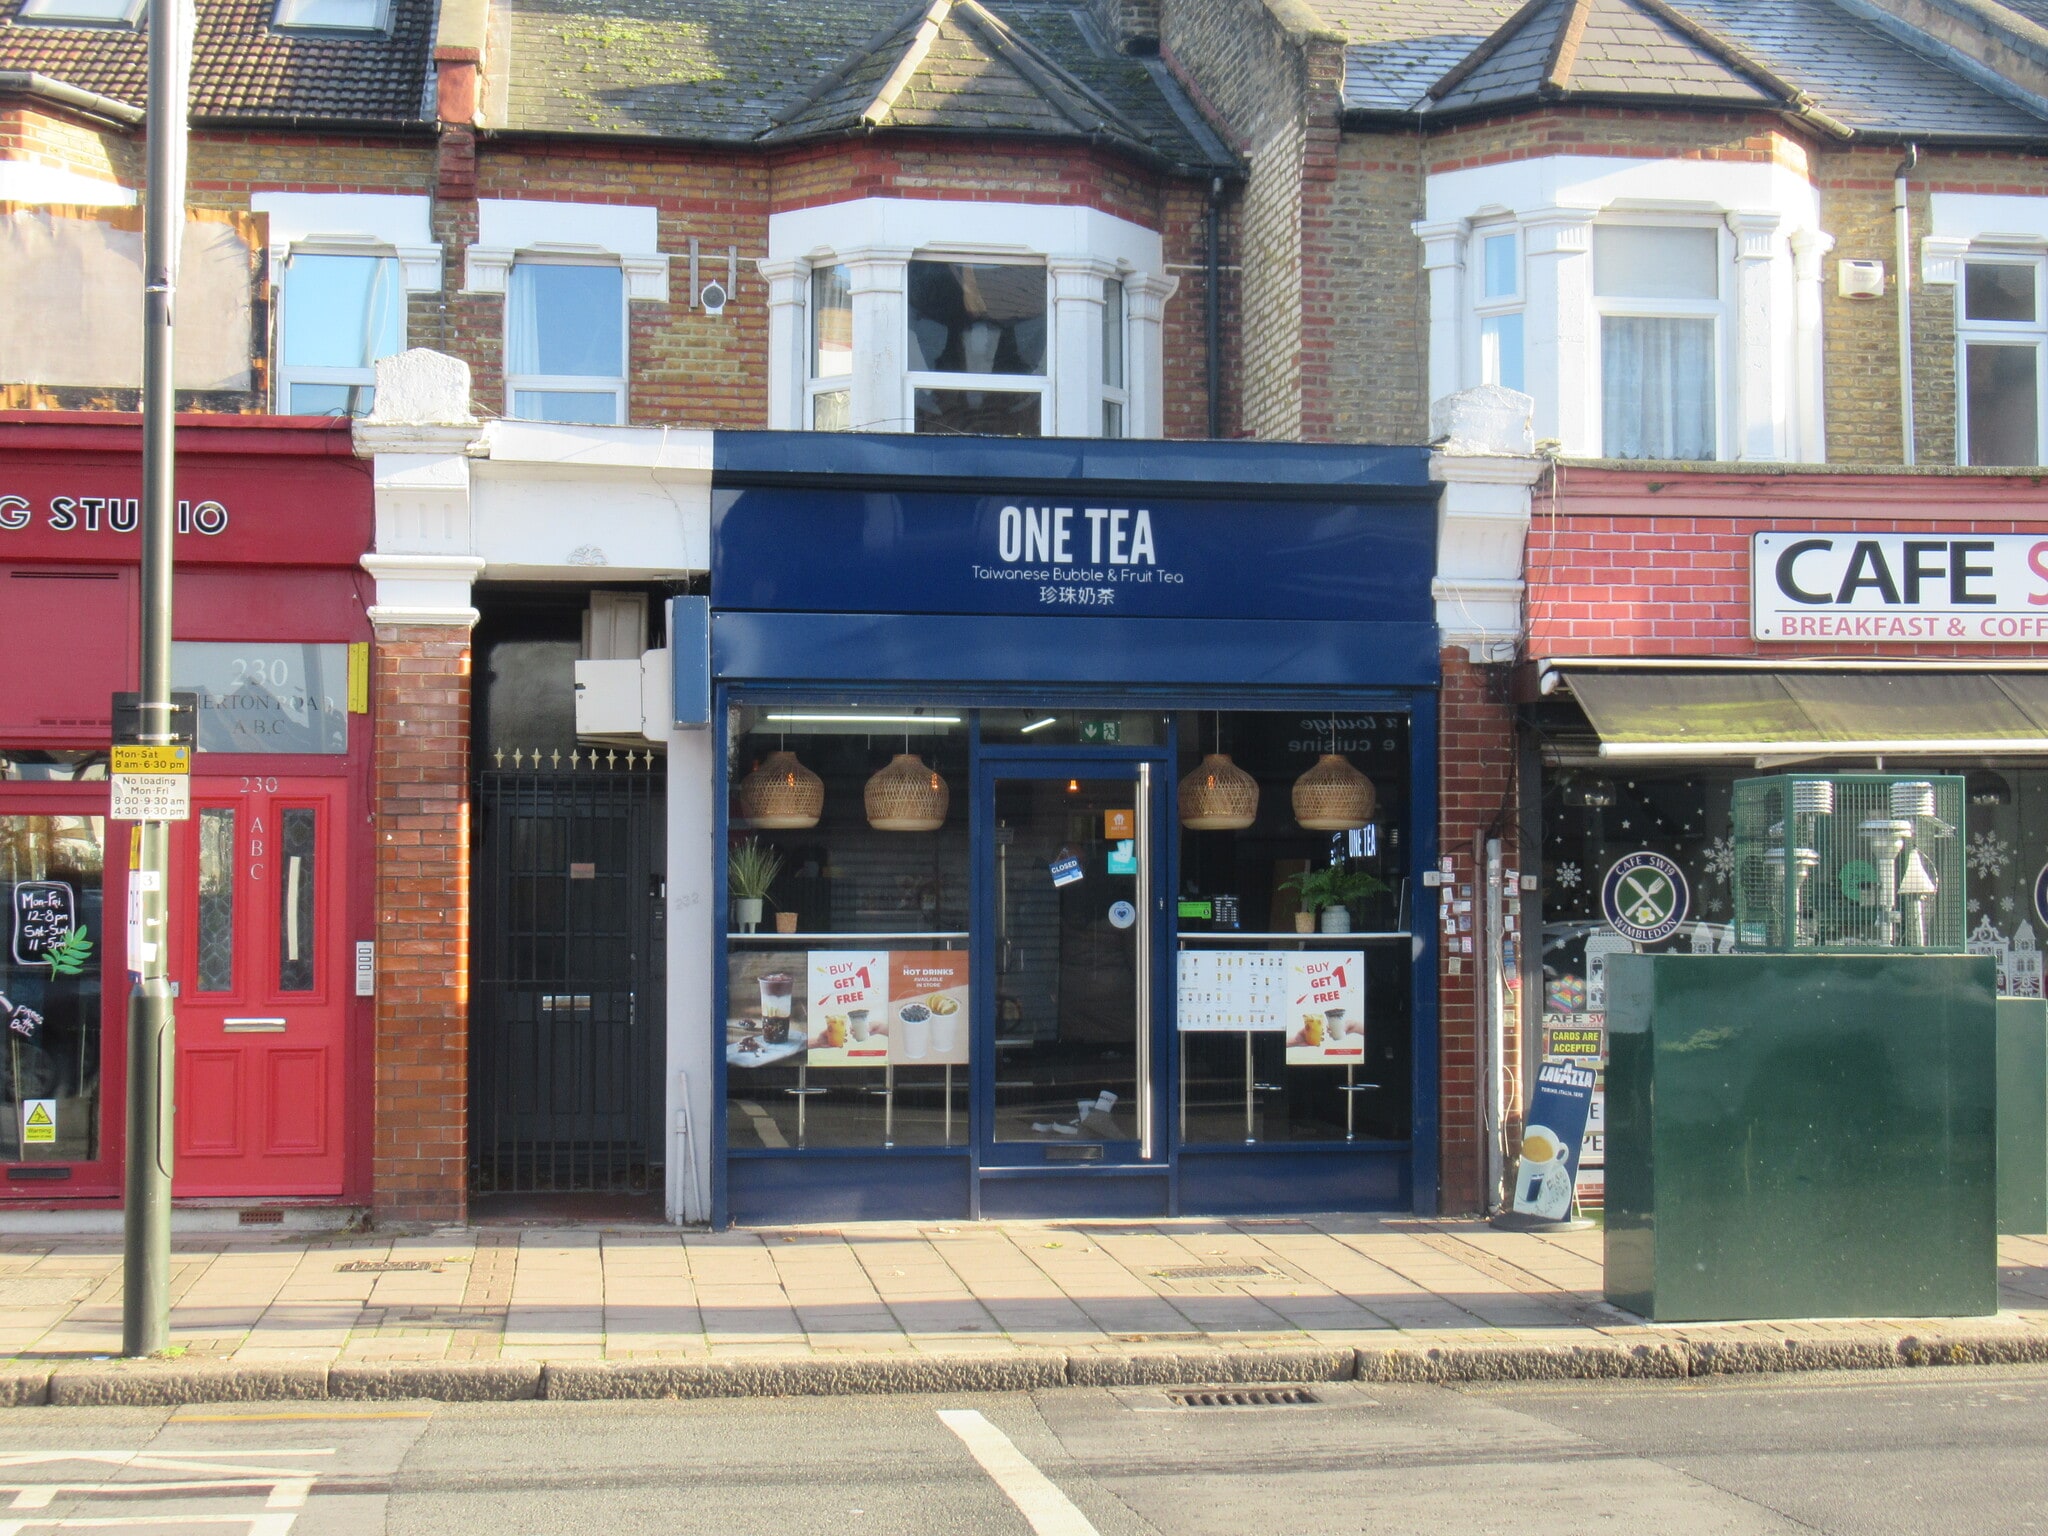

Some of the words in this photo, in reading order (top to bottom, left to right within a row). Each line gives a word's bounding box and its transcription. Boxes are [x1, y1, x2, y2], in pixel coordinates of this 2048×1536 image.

[48, 496, 228, 535] STUIO
[999, 506, 1073, 562] ONE
[1085, 508, 1156, 565] TEA
[972, 565, 1050, 580] Taiwanese
[1053, 567, 1104, 581] Bubble
[1107, 568, 1118, 582] &
[1121, 568, 1153, 583] Fruit
[1156, 569, 1184, 583] Tea
[1775, 538, 1997, 604] CAFE
[1039, 586, 1115, 605] 珍珠奶茶
[1781, 616, 1940, 636] BREAKFAST
[1946, 618, 1966, 636] &
[231, 658, 288, 688] 230
[198, 695, 270, 711] ERTON
[170, 762, 185, 770] pm
[123, 777, 137, 785] No
[140, 777, 176, 787] loading
[240, 777, 278, 793] 230
[170, 808, 185, 816] pm
[1051, 860, 1078, 874] CLOSED
[1615, 855, 1642, 875] CAFE
[1649, 856, 1676, 876] SW19
[1614, 916, 1677, 939] WIMBLEDON
[829, 962, 853, 975] BUY
[903, 968, 921, 976] HOT
[922, 968, 954, 976] DRINKS
[1307, 962, 1330, 975] BUY
[834, 977, 855, 990] GET
[855, 966, 871, 989] 1
[1311, 976, 1332, 989] GET
[1332, 965, 1347, 988] 1
[836, 991, 864, 1005] FREE
[1313, 990, 1340, 1004] FREE
[1553, 1031, 1581, 1041] CARDS
[1582, 1032, 1599, 1041] ARE
[1553, 1043, 1597, 1053] ACCEPTED
[1539, 1063, 1593, 1088] LAVAZZA
